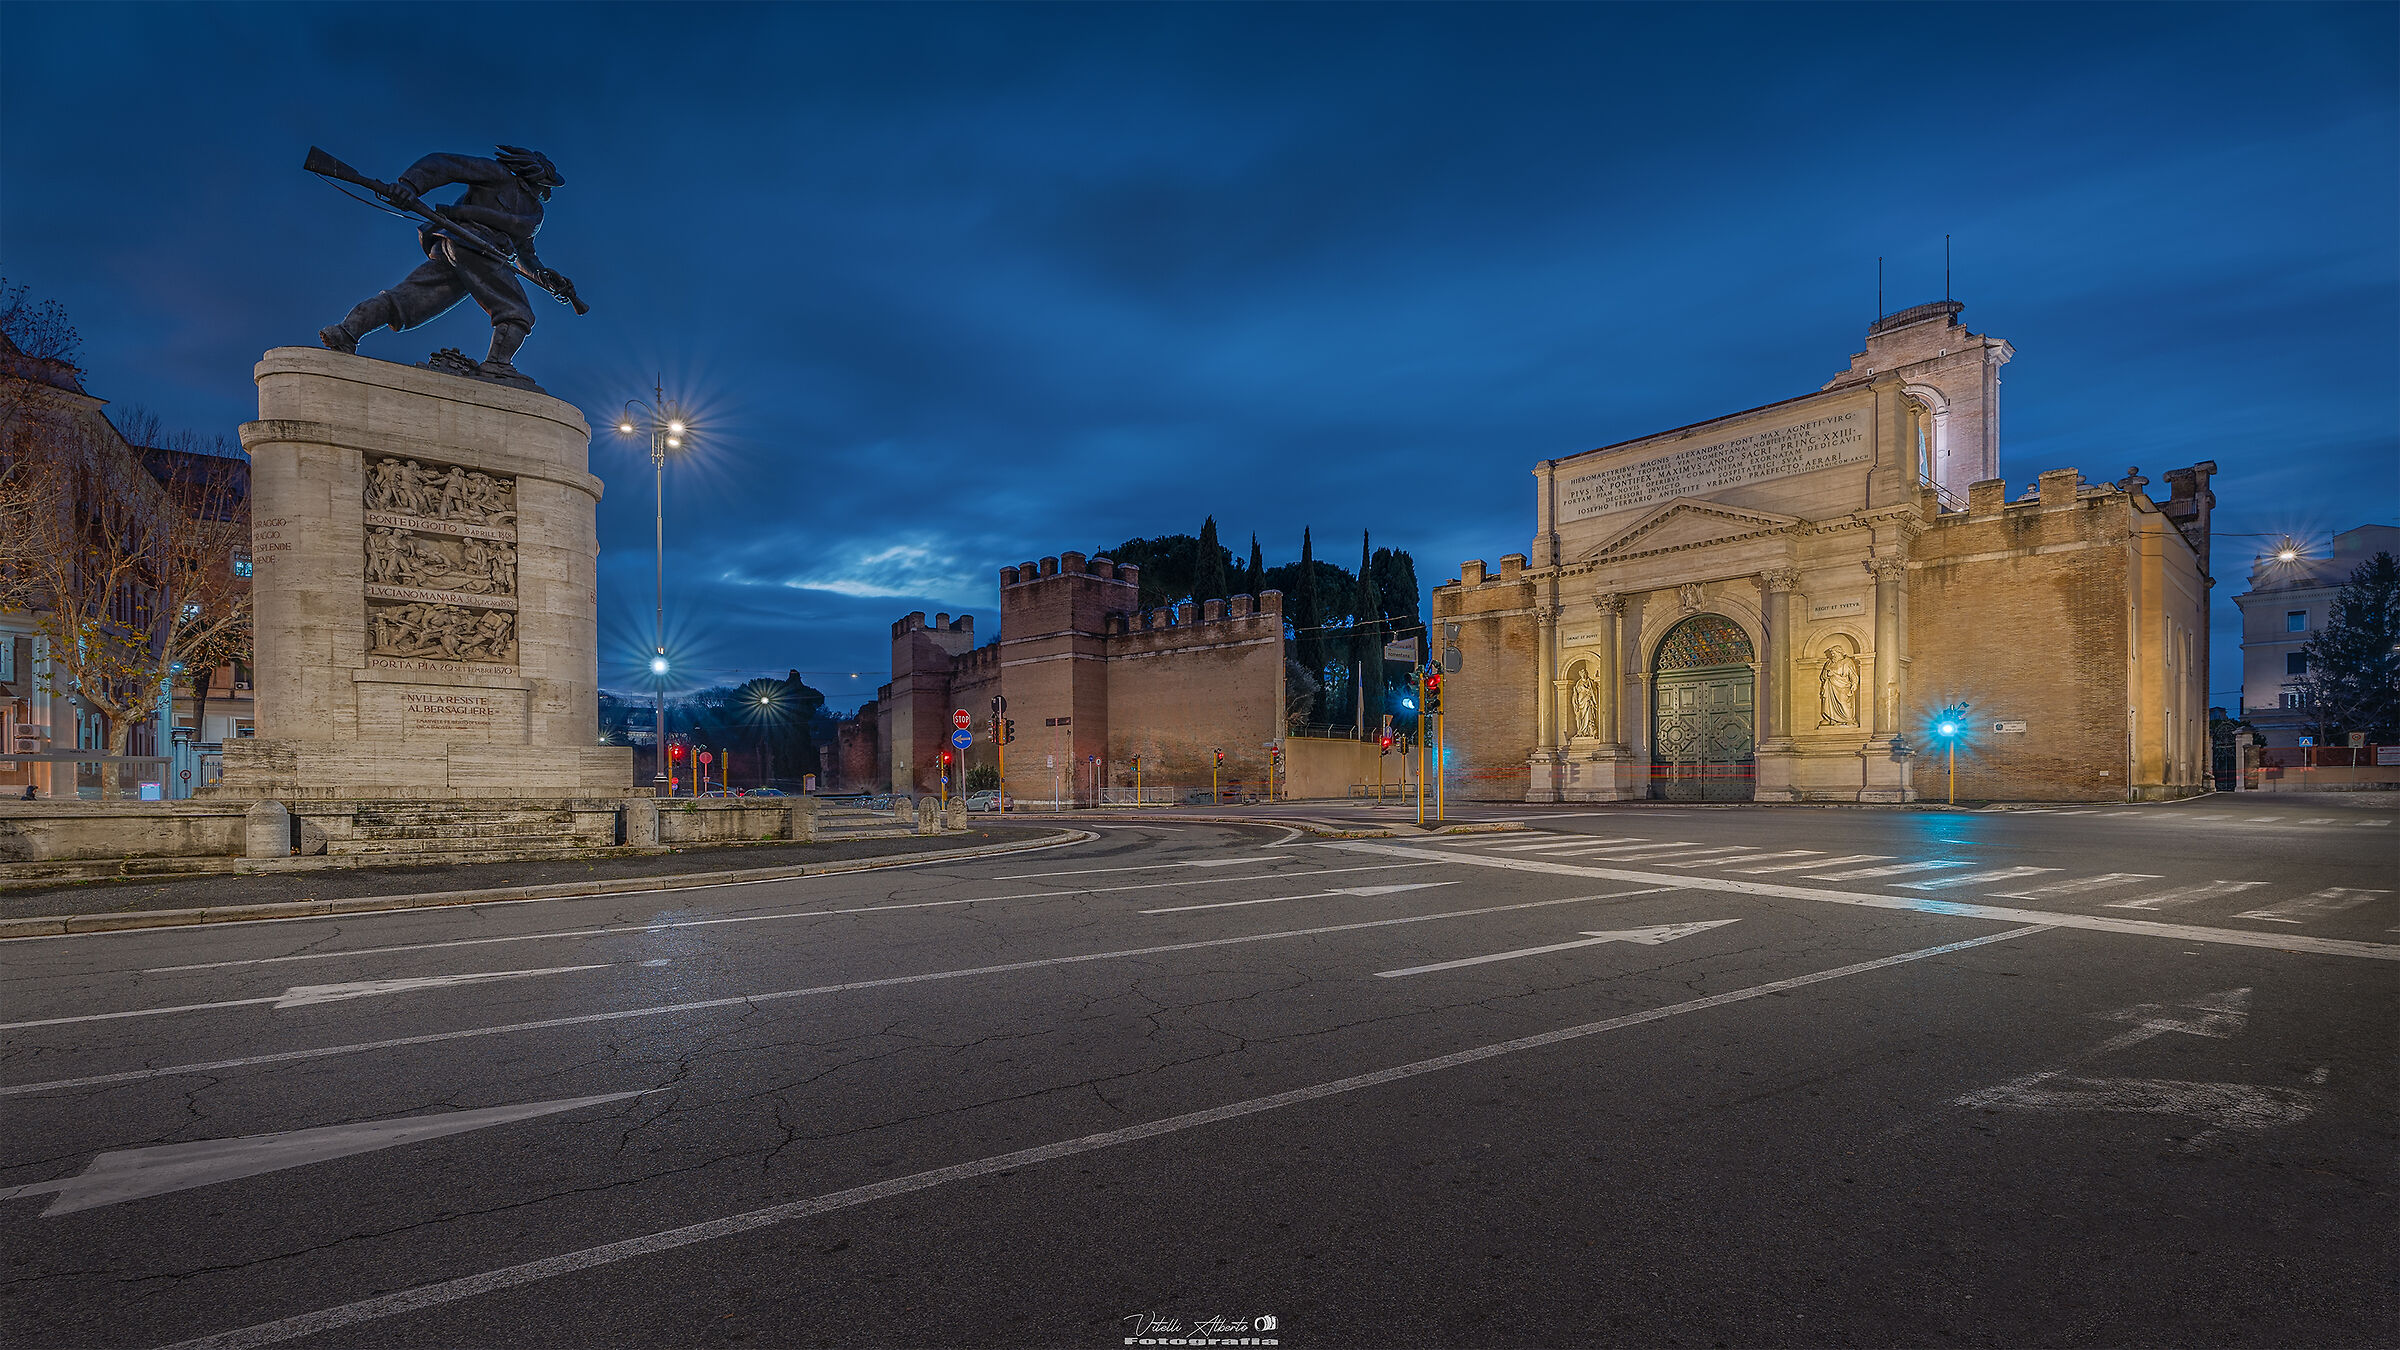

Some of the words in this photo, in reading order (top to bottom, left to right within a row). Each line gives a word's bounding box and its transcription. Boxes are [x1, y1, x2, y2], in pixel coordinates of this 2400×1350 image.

[1570, 464, 1635, 485] HIEROMARTYRIBVS
[1640, 456, 1670, 469] MAGNIS
[1675, 443, 1725, 460] ALEXANDRO
[1730, 436, 1754, 447] PONT
[1760, 430, 1780, 440] MAX
[1786, 420, 1821, 434] AGNETI
[1563, 495, 1592, 506] PORTAM
[1596, 491, 1613, 499] PIAM
[1618, 485, 1640, 494] NOVIS
[1645, 475, 1681, 488] OPERIBVS
[1686, 461, 1744, 479] COMMVNITAM
[1750, 448, 1802, 465] EXORNATAM
[1806, 434, 1863, 452] DEDICAVIT
[1570, 488, 1590, 499] PIVS
[1595, 485, 1605, 493] IX
[1610, 474, 1652, 490] PONTIFEX
[1658, 462, 1702, 479] MAXIMVS
[1707, 455, 1735, 468] ANNO
[1741, 446, 1772, 460] SACRI
[1780, 436, 1817, 451] PRINC
[1601, 472, 1632, 486] QVORVM
[1696, 446, 1746, 461] NOMENTANA
[1648, 482, 1681, 494] INVICTO
[1718, 460, 1775, 478] SOSPITATRICI
[1578, 503, 1609, 515] IOSEPHO
[1658, 484, 1700, 499] ANTISTITE
[1706, 475, 1742, 487] VRBANO
[1748, 462, 1800, 479] PRAEFECTO
[369, 514, 407, 526] PONTE
[408, 518, 419, 528] DI
[421, 521, 458, 533] GOITO
[371, 586, 419, 599] LVCIANO
[420, 592, 464, 603] MANARA
[372, 660, 413, 670] PORTA
[418, 661, 437, 671] PIA
[494, 666, 513, 675] 1870
[407, 694, 444, 703] NVLLA
[446, 695, 488, 705] RESISTE
[424, 705, 494, 716] BERSAGLIERE
[955, 715, 969, 723] STOP
